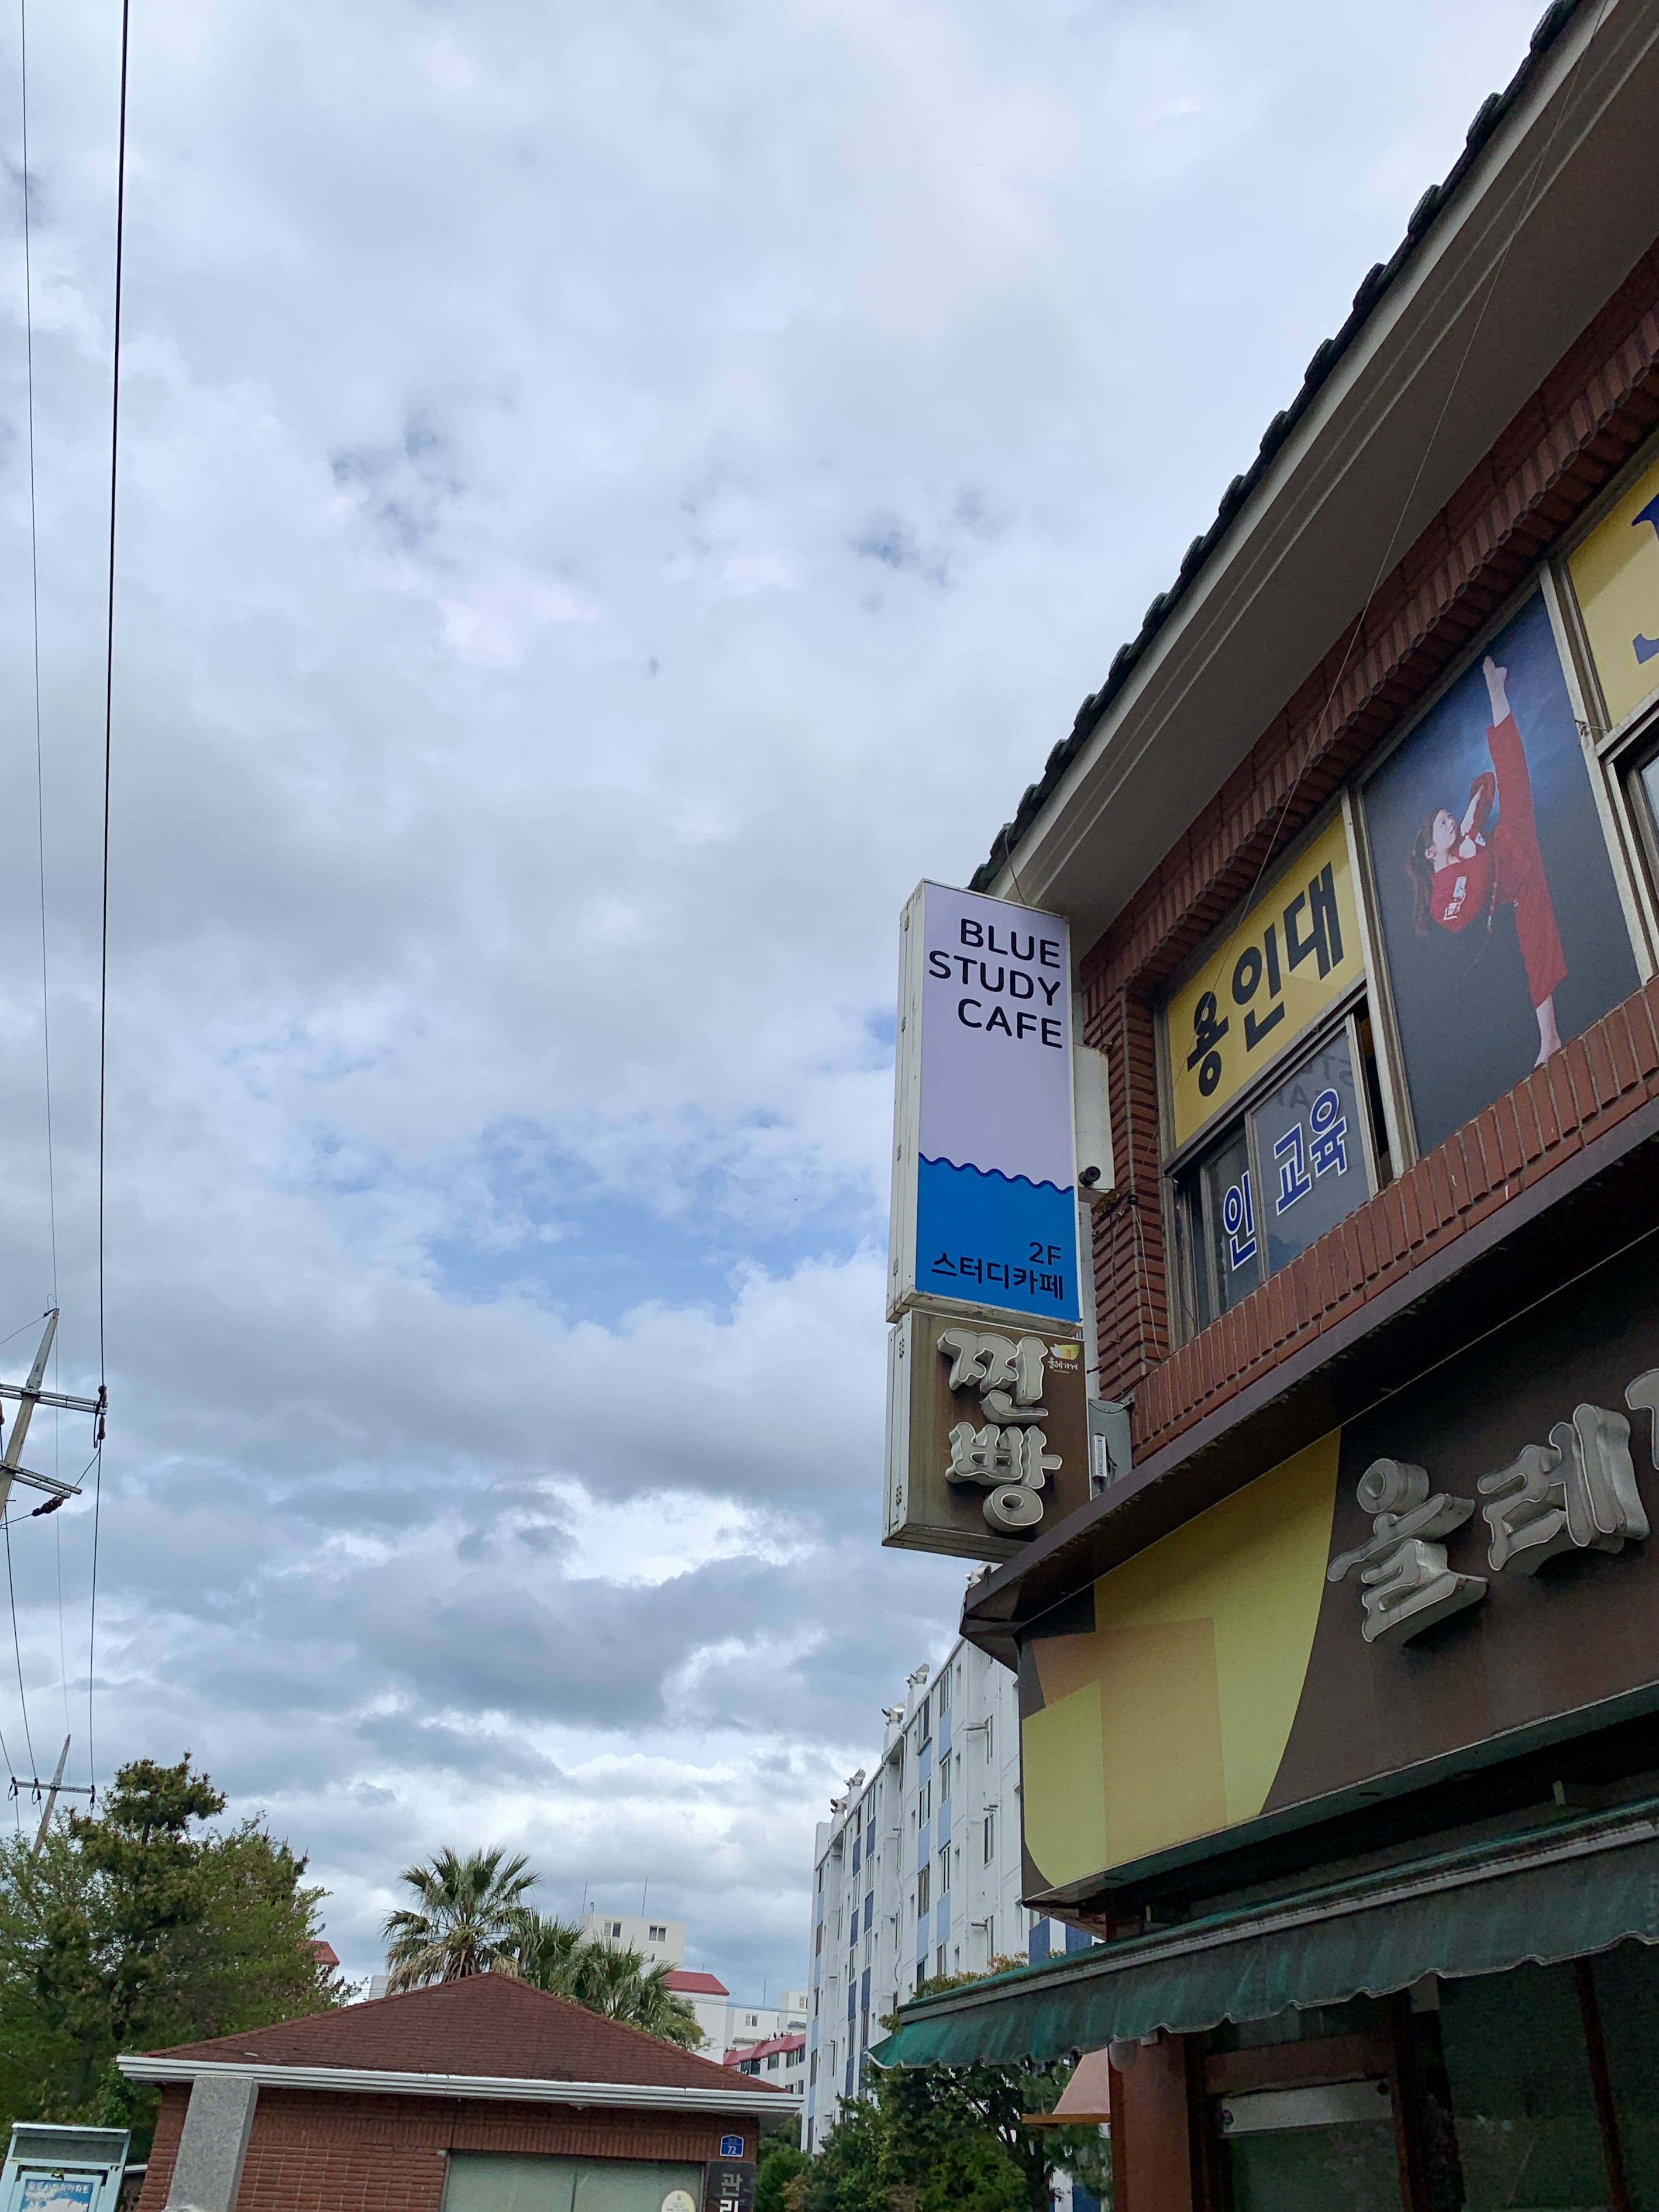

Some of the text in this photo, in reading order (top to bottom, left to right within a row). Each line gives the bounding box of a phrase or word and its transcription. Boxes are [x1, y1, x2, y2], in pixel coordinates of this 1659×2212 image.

[961, 918, 1061, 969] BLUE
[928, 950, 1061, 1007] STUDY
[1187, 861, 1345, 1098] 용인대
[958, 998, 1063, 1049] CAFE
[1273, 1088, 1348, 1216] 교육
[931, 1252, 1064, 1301] 스터디카페
[1028, 1241, 1062, 1267] 2F
[1047, 1356, 1078, 1370] 올레가게
[937, 1328, 1062, 1532] 찐빵
[1327, 1368, 1659, 1645] 올레
[727, 2146, 736, 2155] 72
